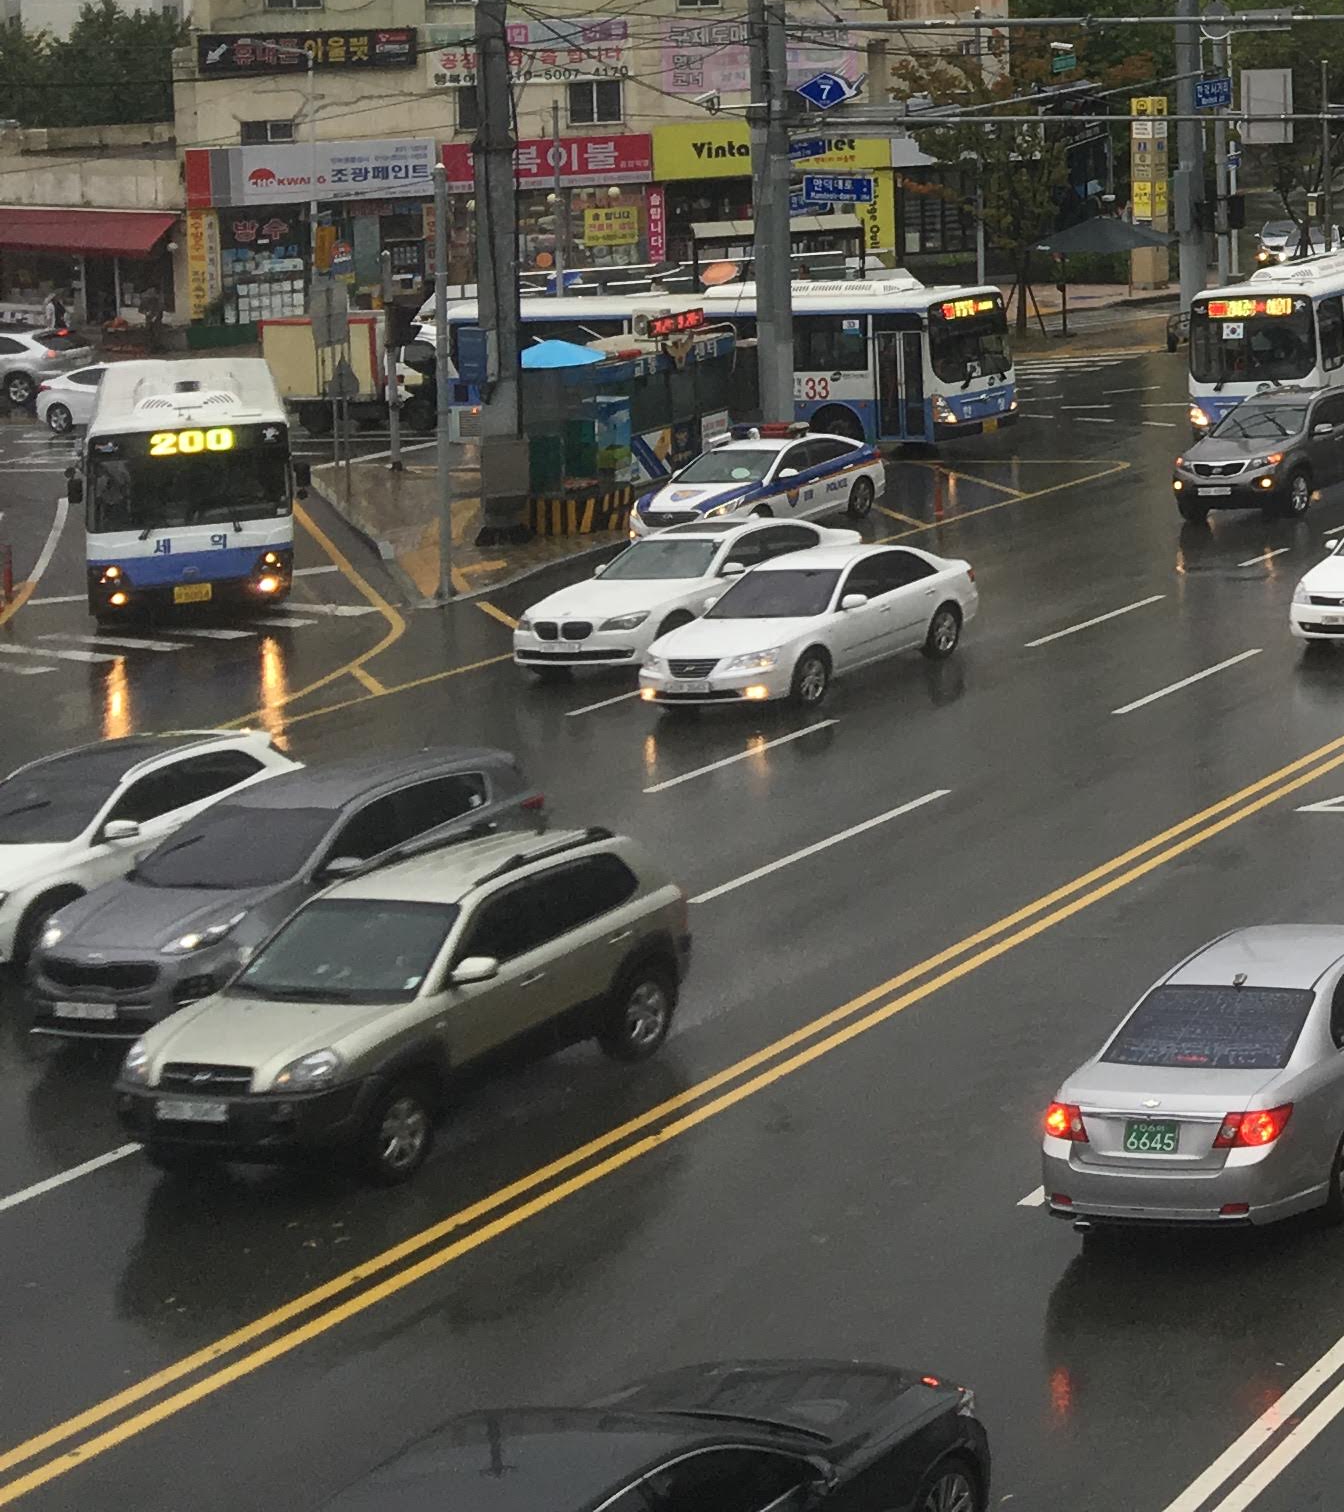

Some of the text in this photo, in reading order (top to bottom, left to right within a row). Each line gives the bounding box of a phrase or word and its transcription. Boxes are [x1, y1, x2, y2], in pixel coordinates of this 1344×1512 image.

[819, 84, 832, 101] 7
[691, 140, 750, 160] Vinta
[330, 164, 430, 184] 조광페인트
[805, 376, 830, 400] 33
[149, 427, 234, 456] 200
[1126, 1132, 1175, 1151] 6645
